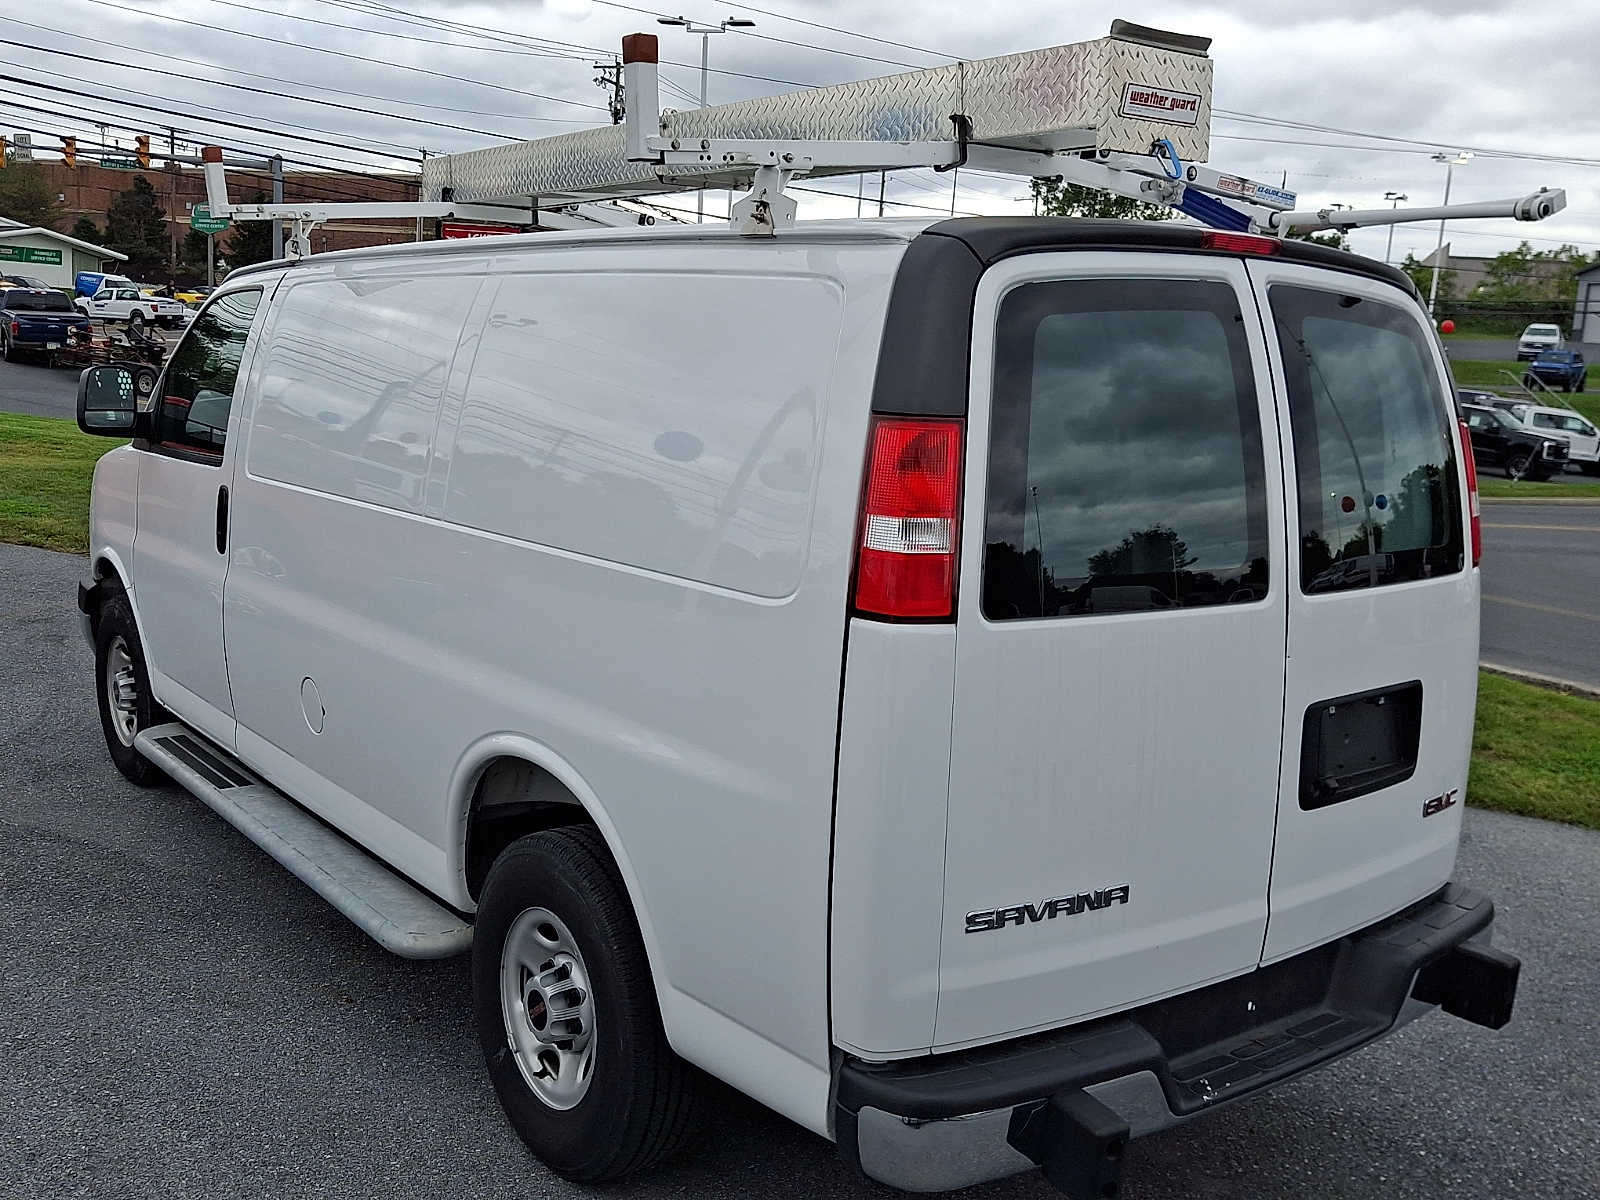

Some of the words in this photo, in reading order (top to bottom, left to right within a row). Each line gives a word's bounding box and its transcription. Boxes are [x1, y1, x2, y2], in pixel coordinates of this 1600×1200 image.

[1129, 90, 1169, 107] weather
[1170, 97, 1197, 112] guard
[964, 883, 1131, 934] SAVANA
